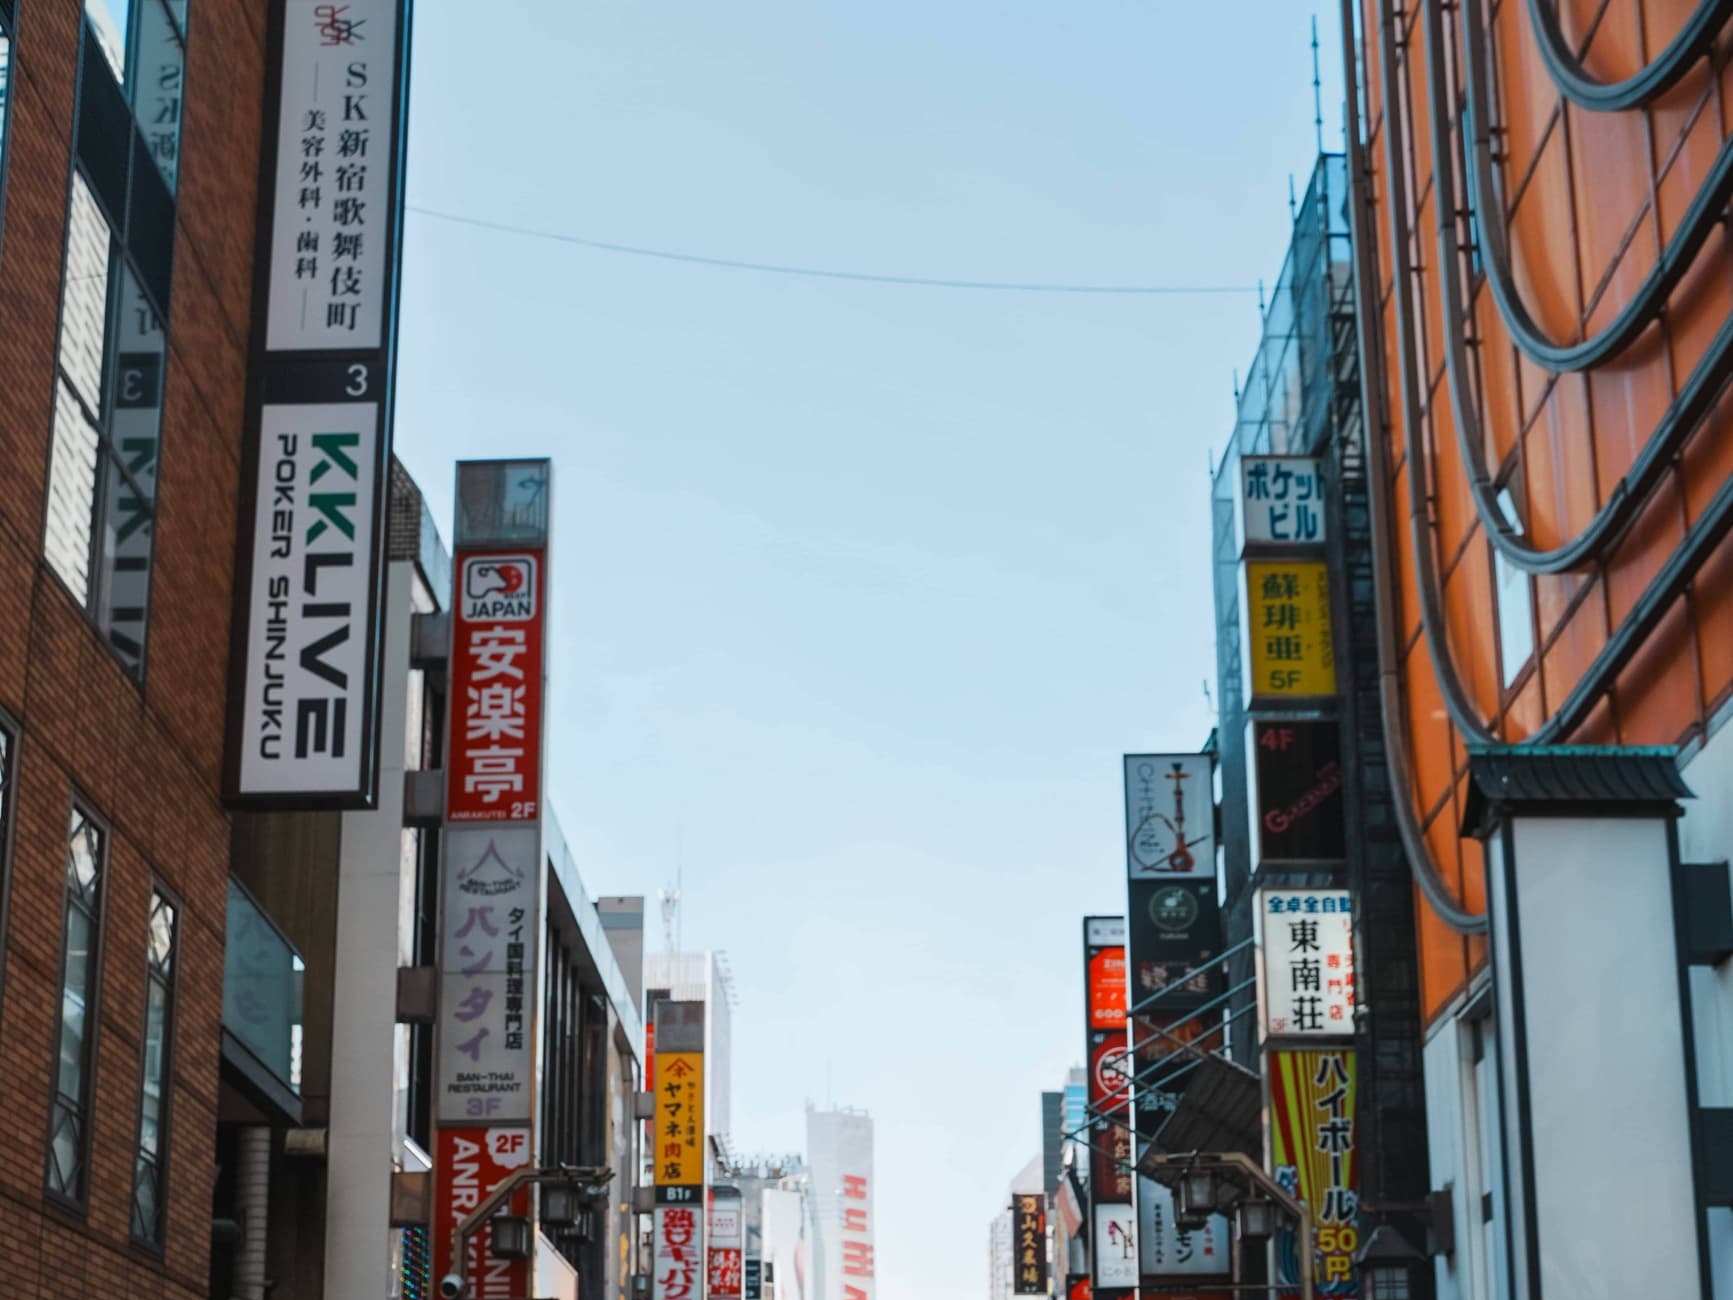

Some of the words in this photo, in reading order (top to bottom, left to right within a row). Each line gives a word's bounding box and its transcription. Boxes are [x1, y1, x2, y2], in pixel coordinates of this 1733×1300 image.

[326, 61, 369, 331] SK新宿歌舞伎町
[345, 364, 369, 397] 3
[270, 433, 298, 560] POKER
[1248, 462, 1323, 500] ポケット
[1270, 504, 1317, 540] ビル
[294, 432, 360, 759] KKLIVE
[466, 601, 531, 618] JAPAN
[259, 575, 290, 760] SHINJUKU
[1270, 671, 1301, 689] 5F
[464, 626, 527, 803] 安楽亭
[1261, 728, 1294, 751] 4F
[511, 801, 536, 819] 2F
[453, 906, 499, 1062] バンタイ
[1288, 920, 1324, 1031] 東南荘
[448, 1083, 521, 1093] RESTAURANT
[456, 1072, 514, 1083] BAN-THAI
[465, 1097, 501, 1117] 3F
[496, 1134, 525, 1153] 2F
[663, 1082, 682, 1180] ヤマネ肉店
[1316, 1056, 1354, 1222] ハイボール
[1318, 1228, 1357, 1251] 50
[1326, 1256, 1351, 1281] 円
